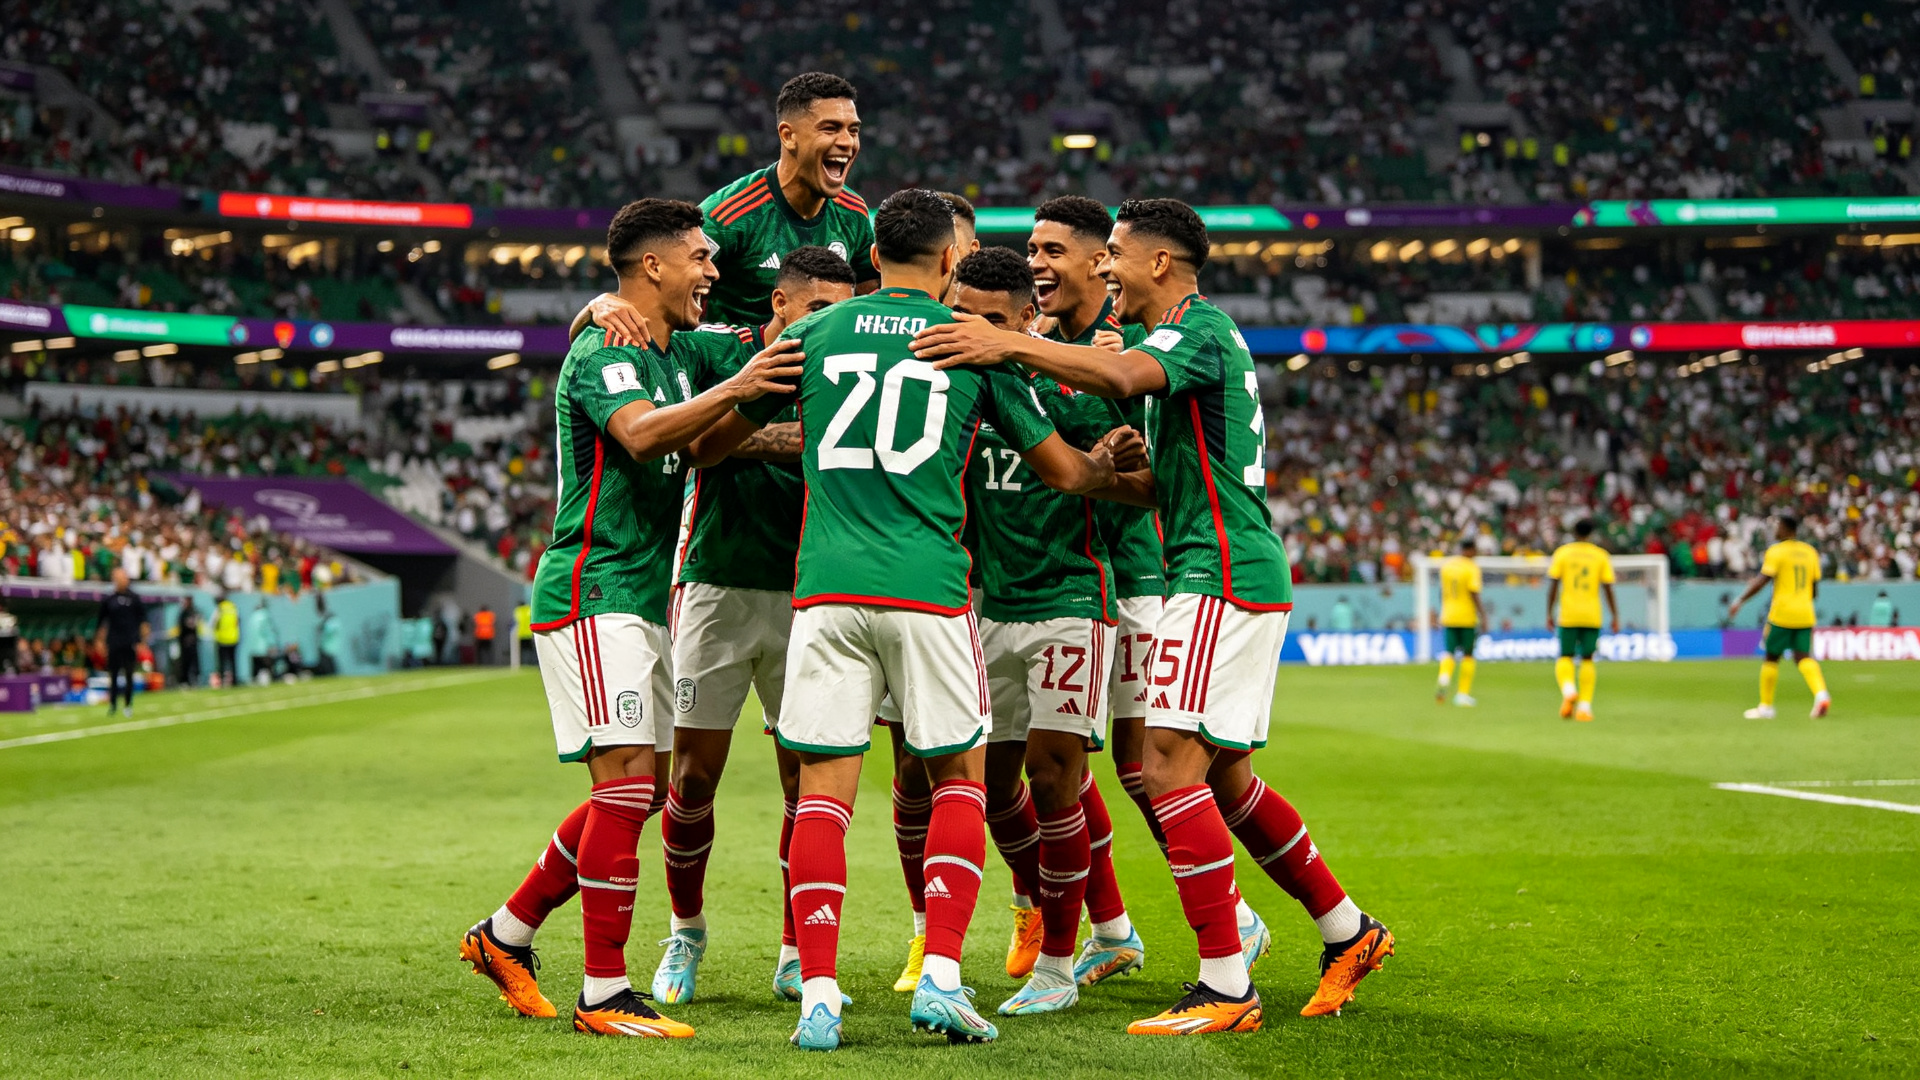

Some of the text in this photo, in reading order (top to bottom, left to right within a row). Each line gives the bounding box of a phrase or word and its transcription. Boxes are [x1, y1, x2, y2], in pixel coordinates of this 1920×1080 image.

[817, 352, 950, 476] 20
[981, 447, 1022, 491] 12
[1040, 644, 1087, 693] 12
